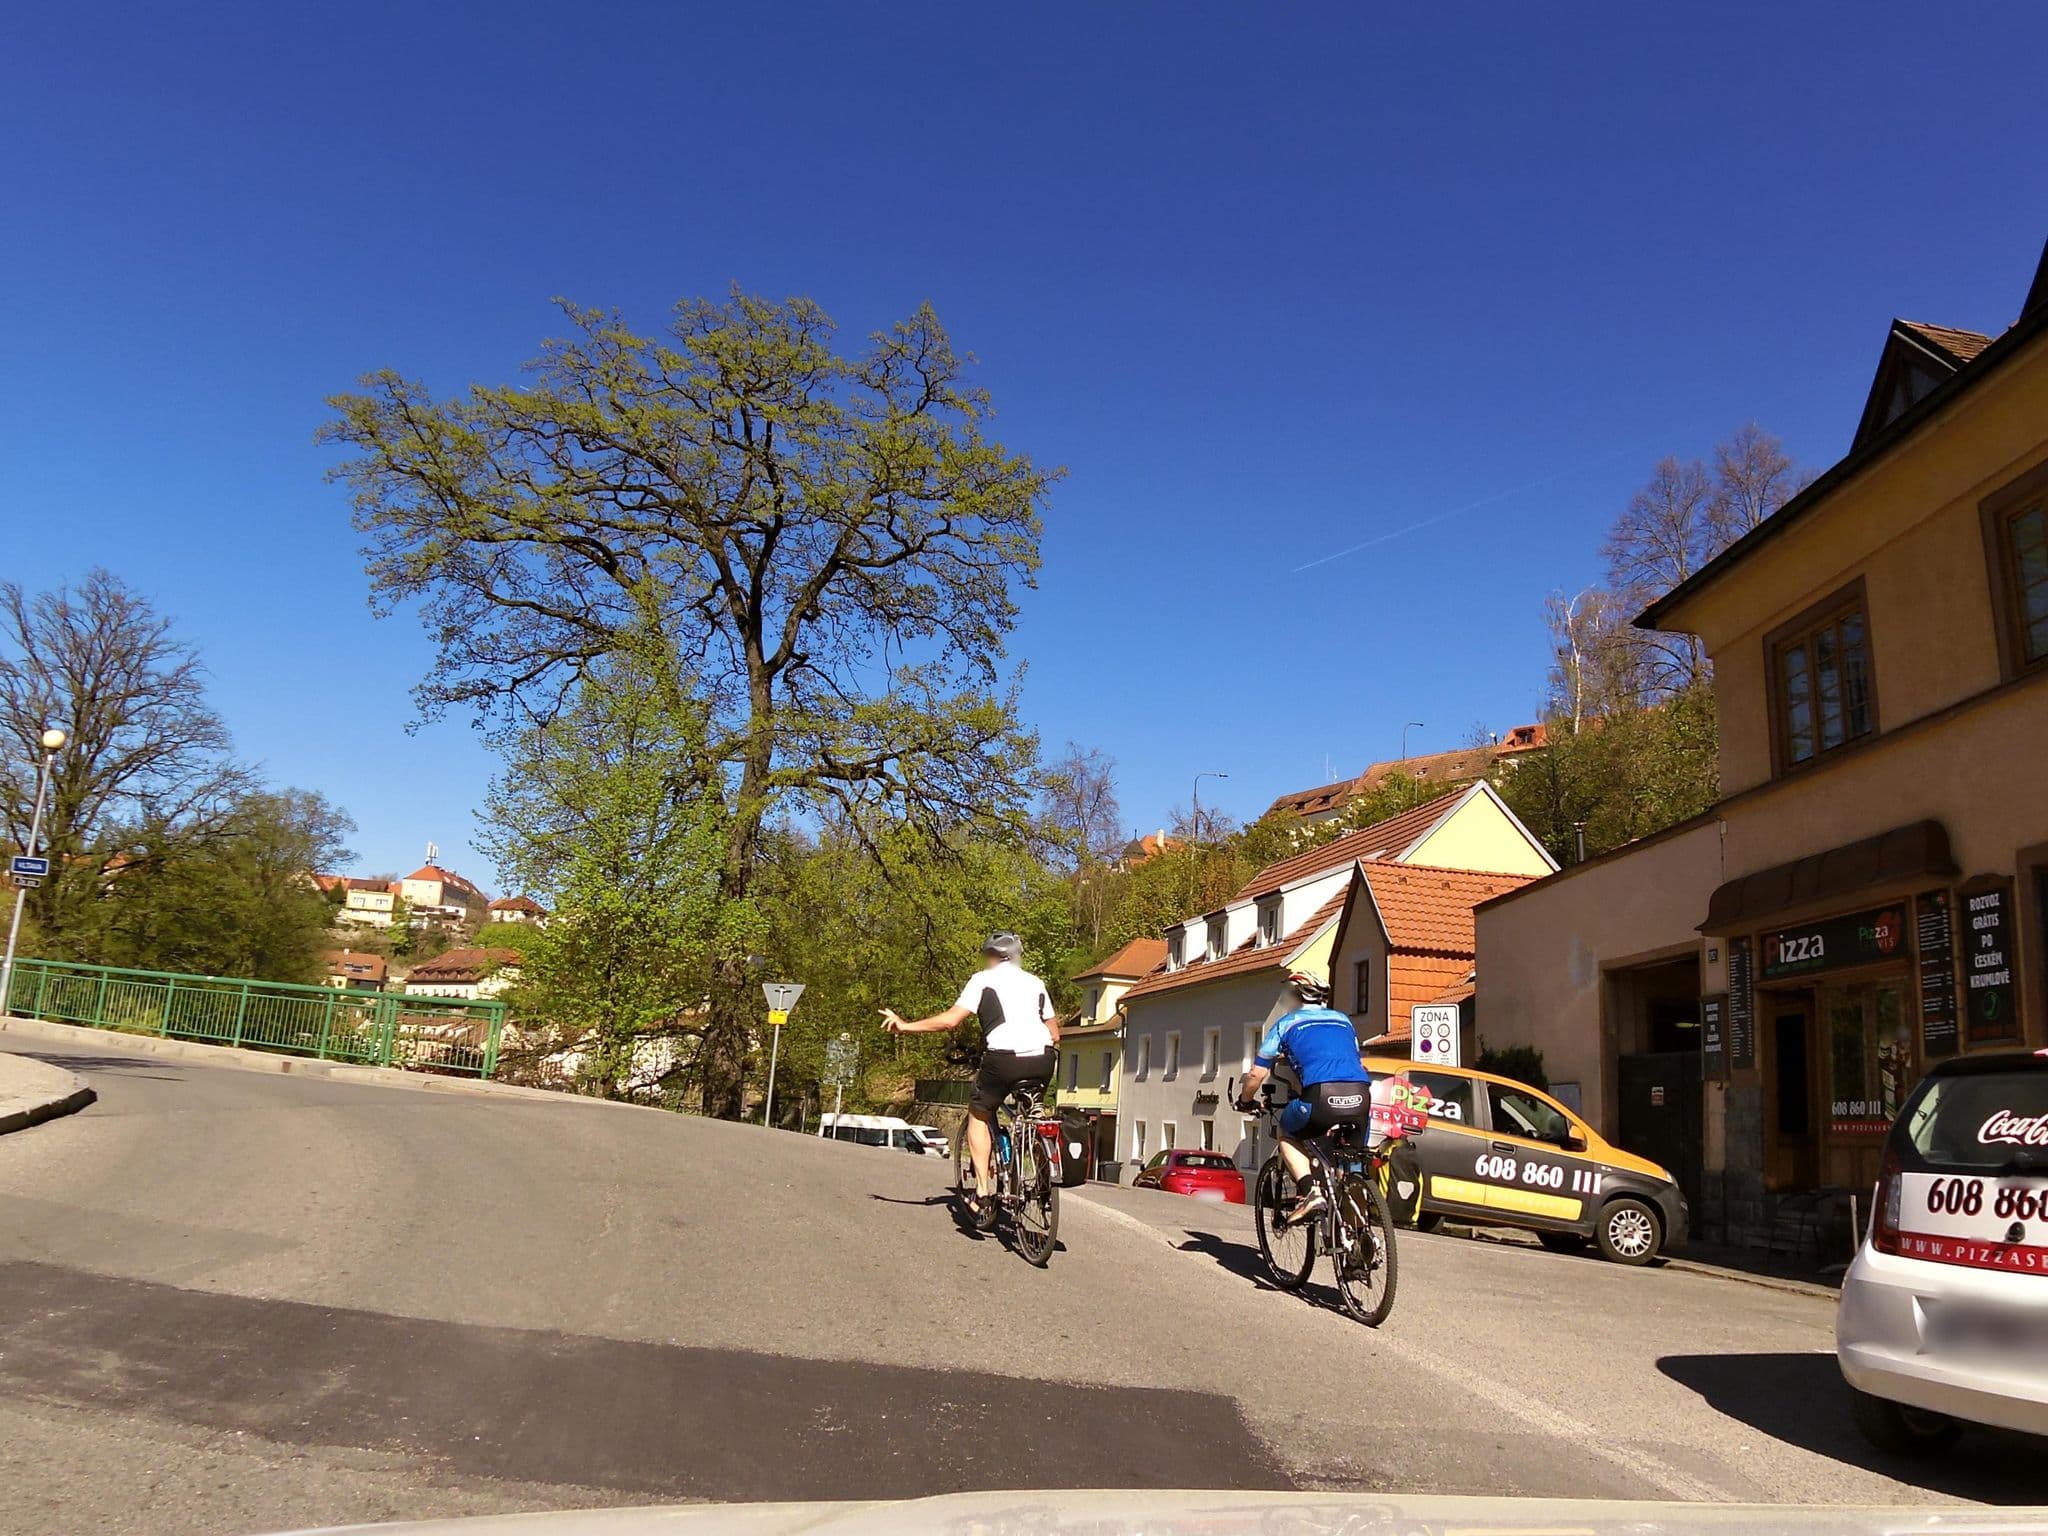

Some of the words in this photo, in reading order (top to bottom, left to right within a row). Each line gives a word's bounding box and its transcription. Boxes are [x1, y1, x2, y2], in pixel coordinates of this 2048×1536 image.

[1969, 893, 2000, 911] ROZVOZ
[1981, 933, 1993, 948] PO
[1831, 1100, 1847, 1116] 608
[1868, 1099, 1881, 1115] 111
[1369, 1108, 1419, 1126] ERVIS
[1475, 1153, 1517, 1180] 608
[1522, 1161, 1564, 1189] 860
[1572, 1169, 1602, 1195] 111
[1927, 1178, 1984, 1216] 608
